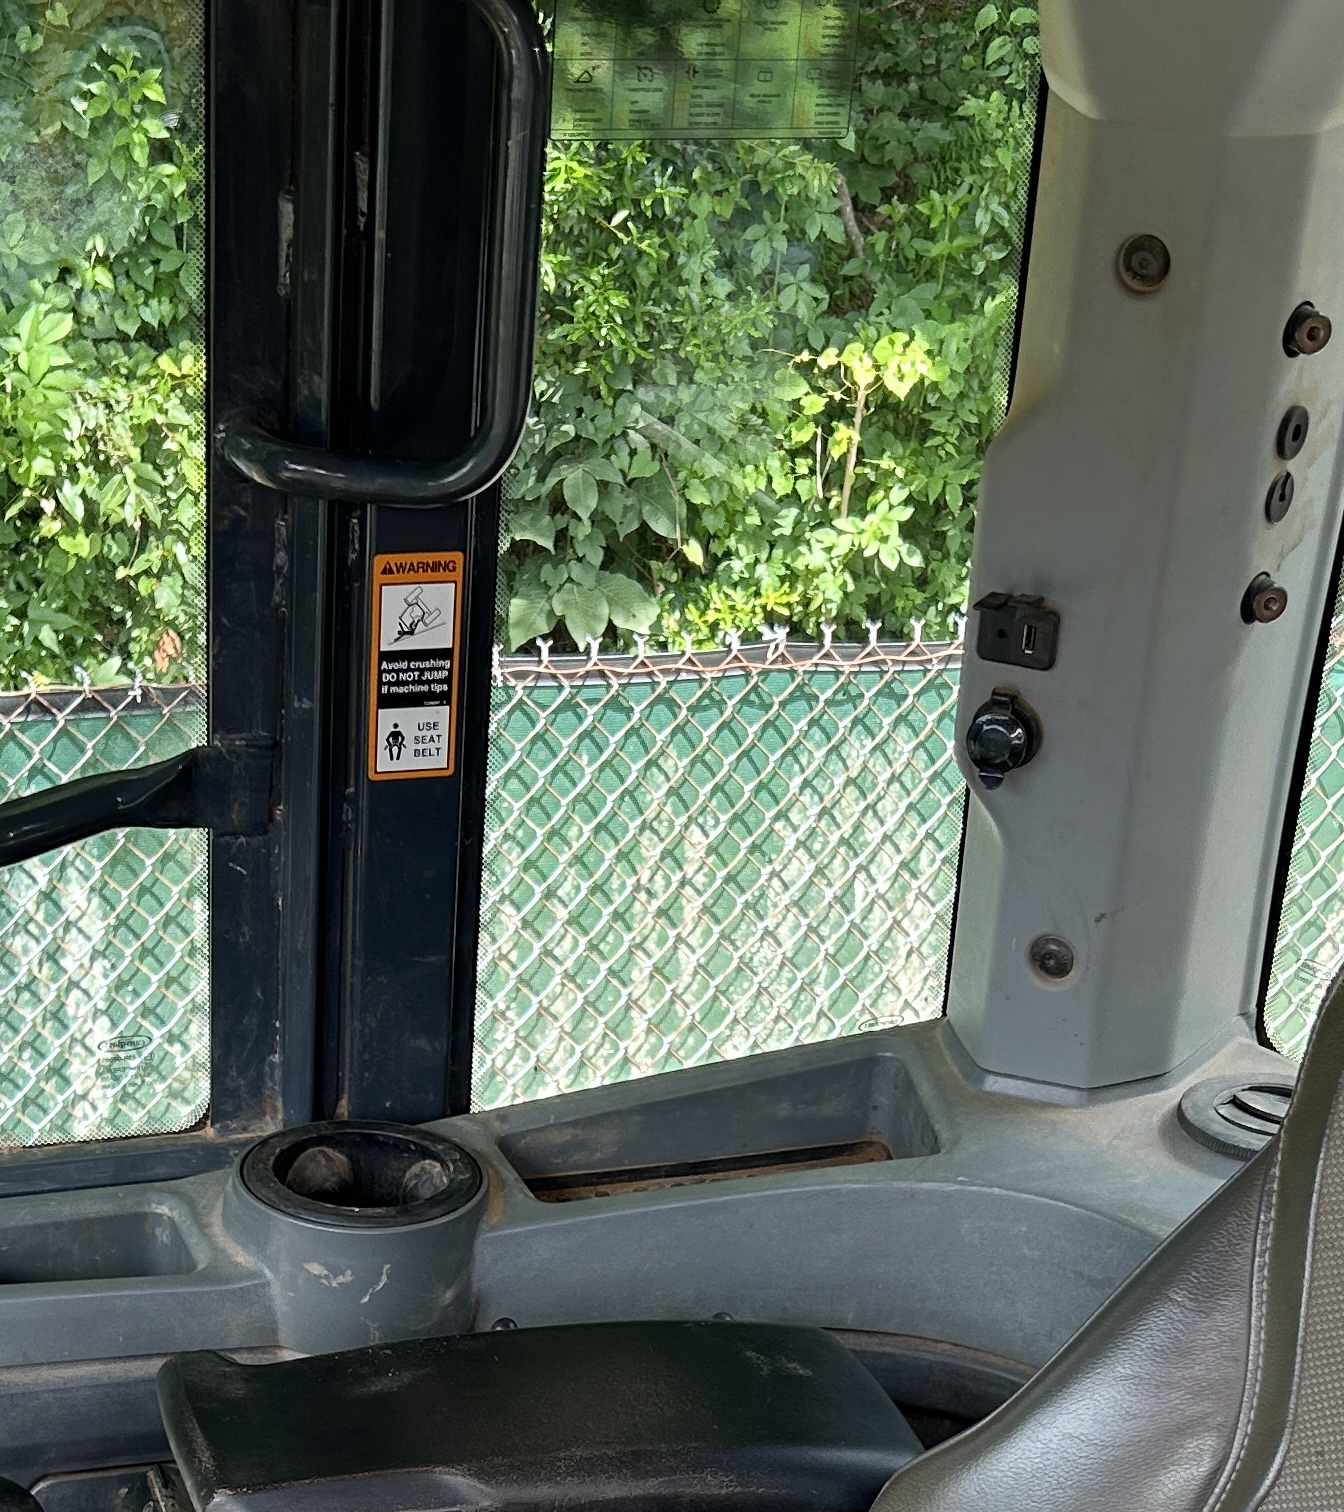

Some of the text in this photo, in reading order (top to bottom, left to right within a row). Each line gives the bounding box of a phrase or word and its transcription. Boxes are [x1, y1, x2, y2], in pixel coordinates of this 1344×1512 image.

[394, 559, 457, 575] WARNING
[381, 658, 451, 670] Avoid crushing
[382, 670, 449, 682] DO NOT JUMP
[389, 683, 429, 694] machine
[430, 682, 449, 693] tips
[417, 721, 440, 731] USE
[413, 734, 443, 744] SEAT
[413, 747, 442, 757] BELT
